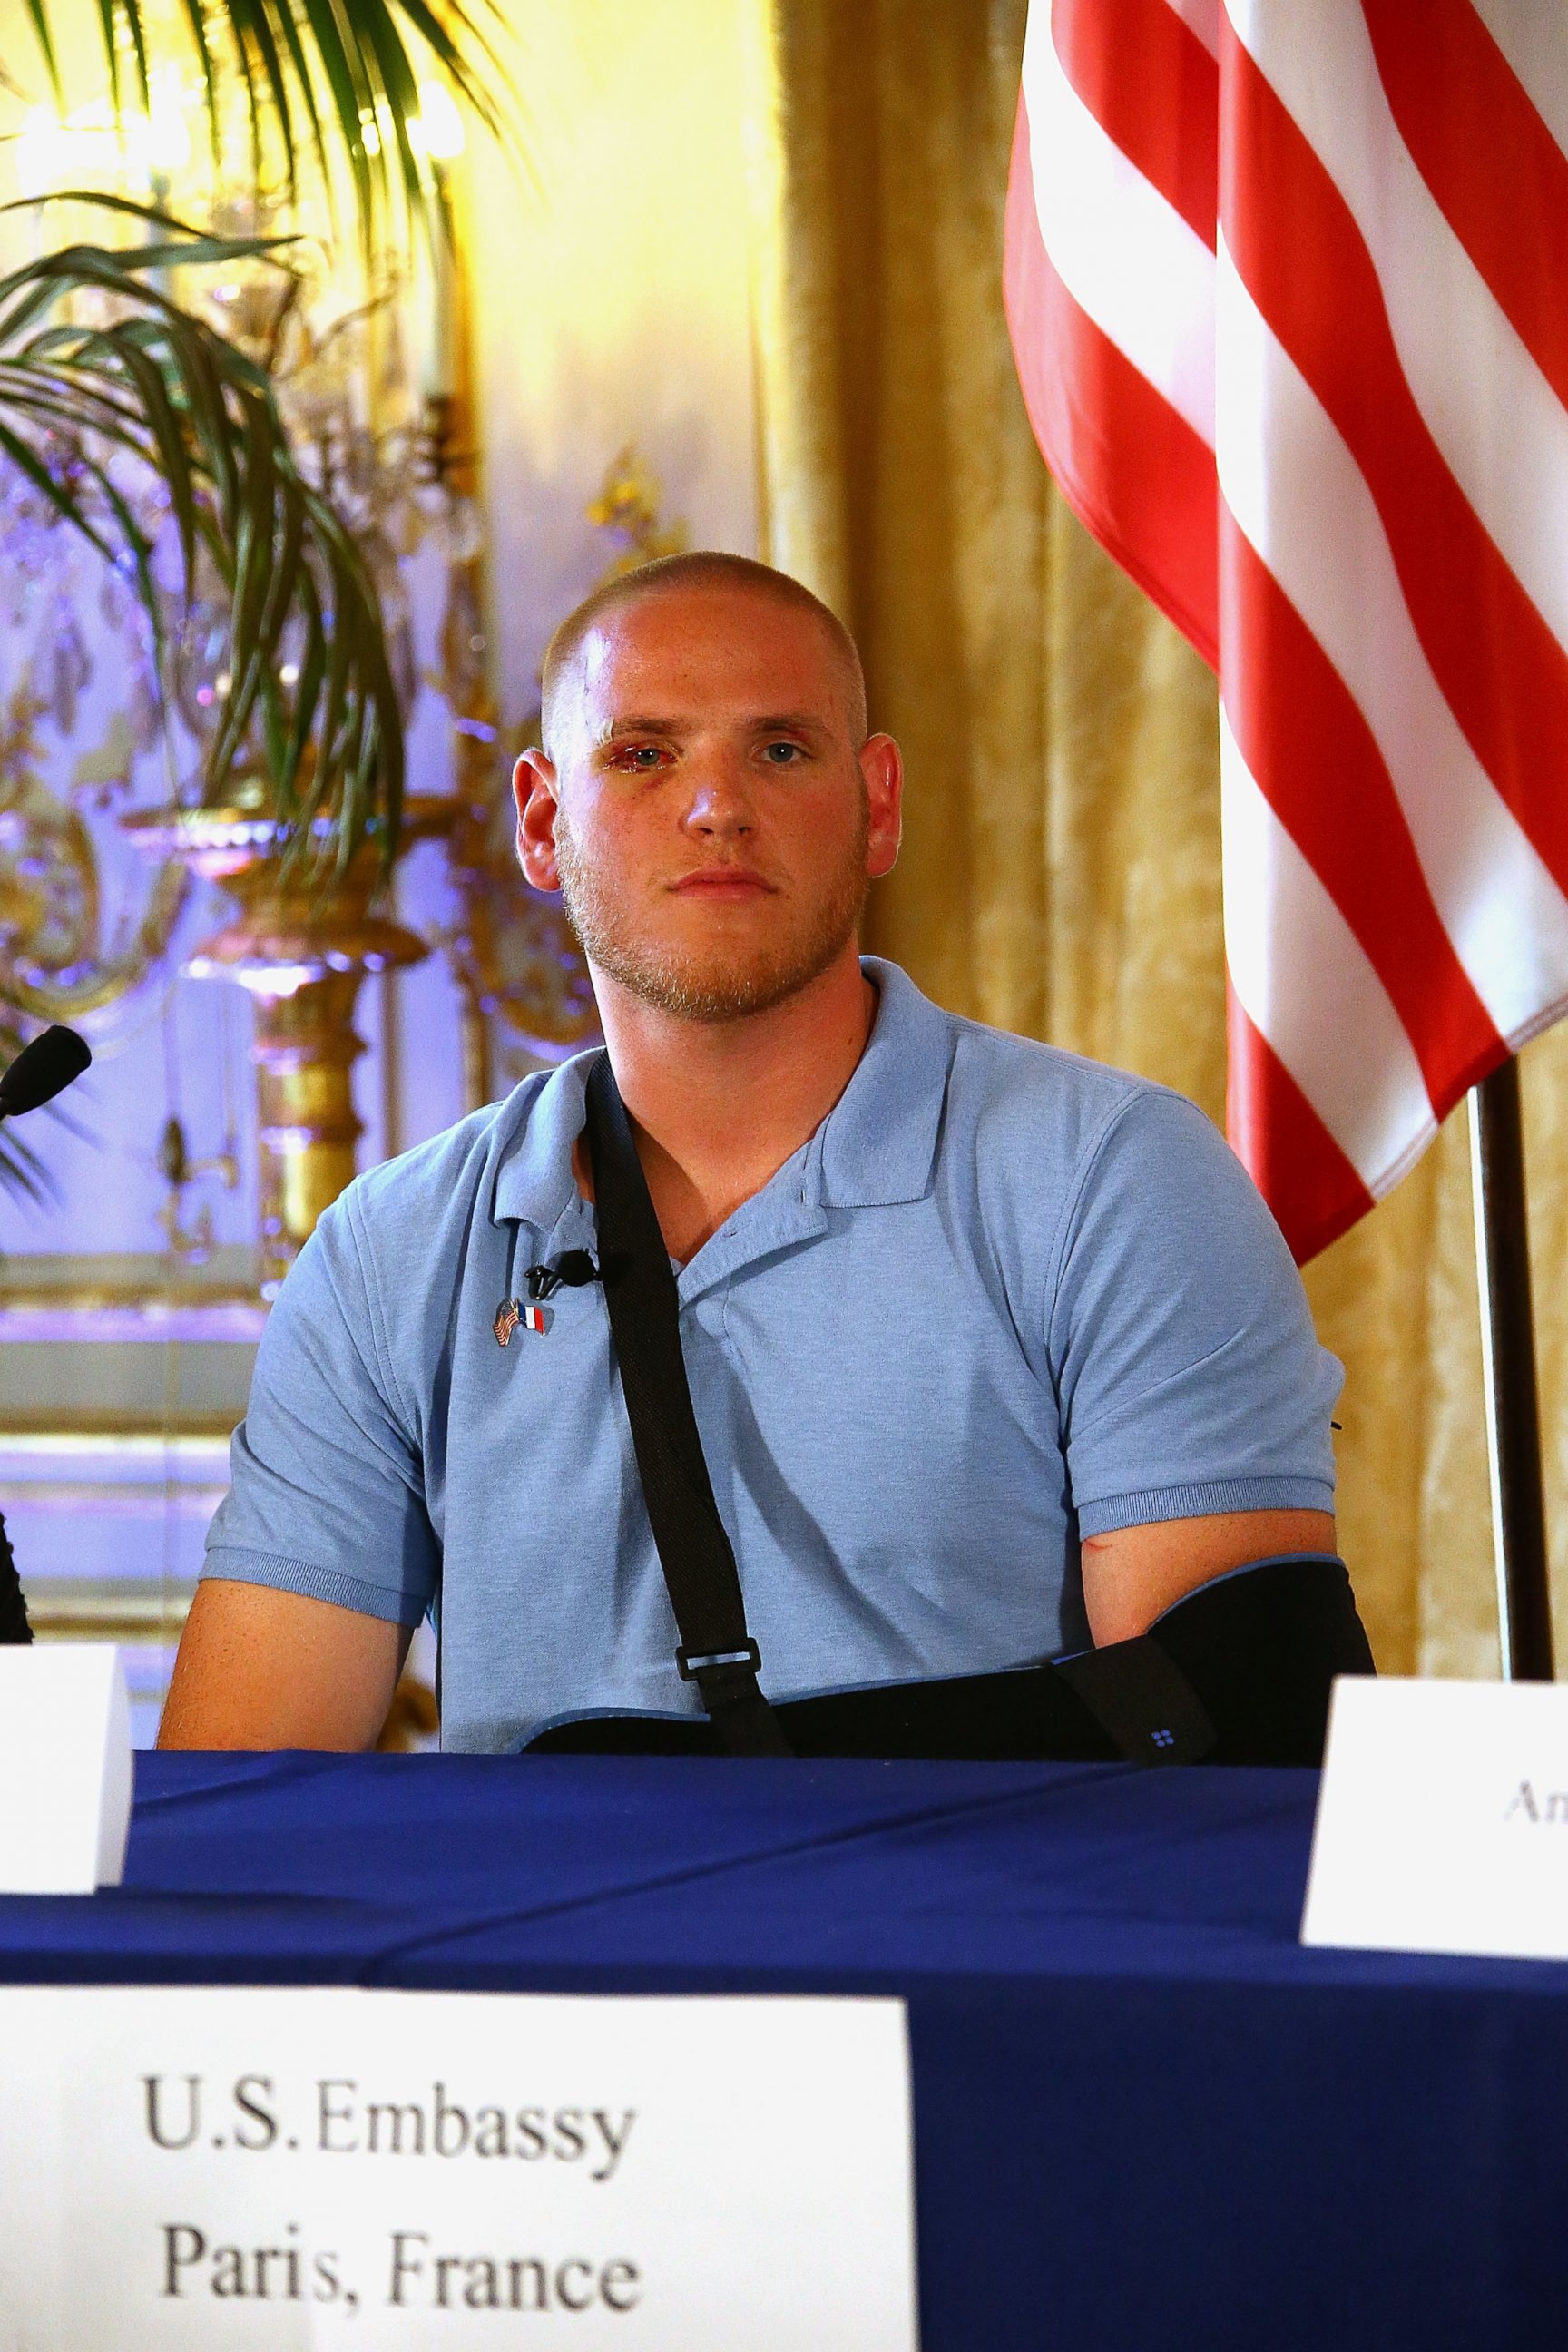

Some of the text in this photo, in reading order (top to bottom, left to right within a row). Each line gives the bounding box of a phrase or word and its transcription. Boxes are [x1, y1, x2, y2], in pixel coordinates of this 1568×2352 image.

[142, 2074, 637, 2184] U.S. Embassy
[159, 2222, 642, 2316] Paris, France
